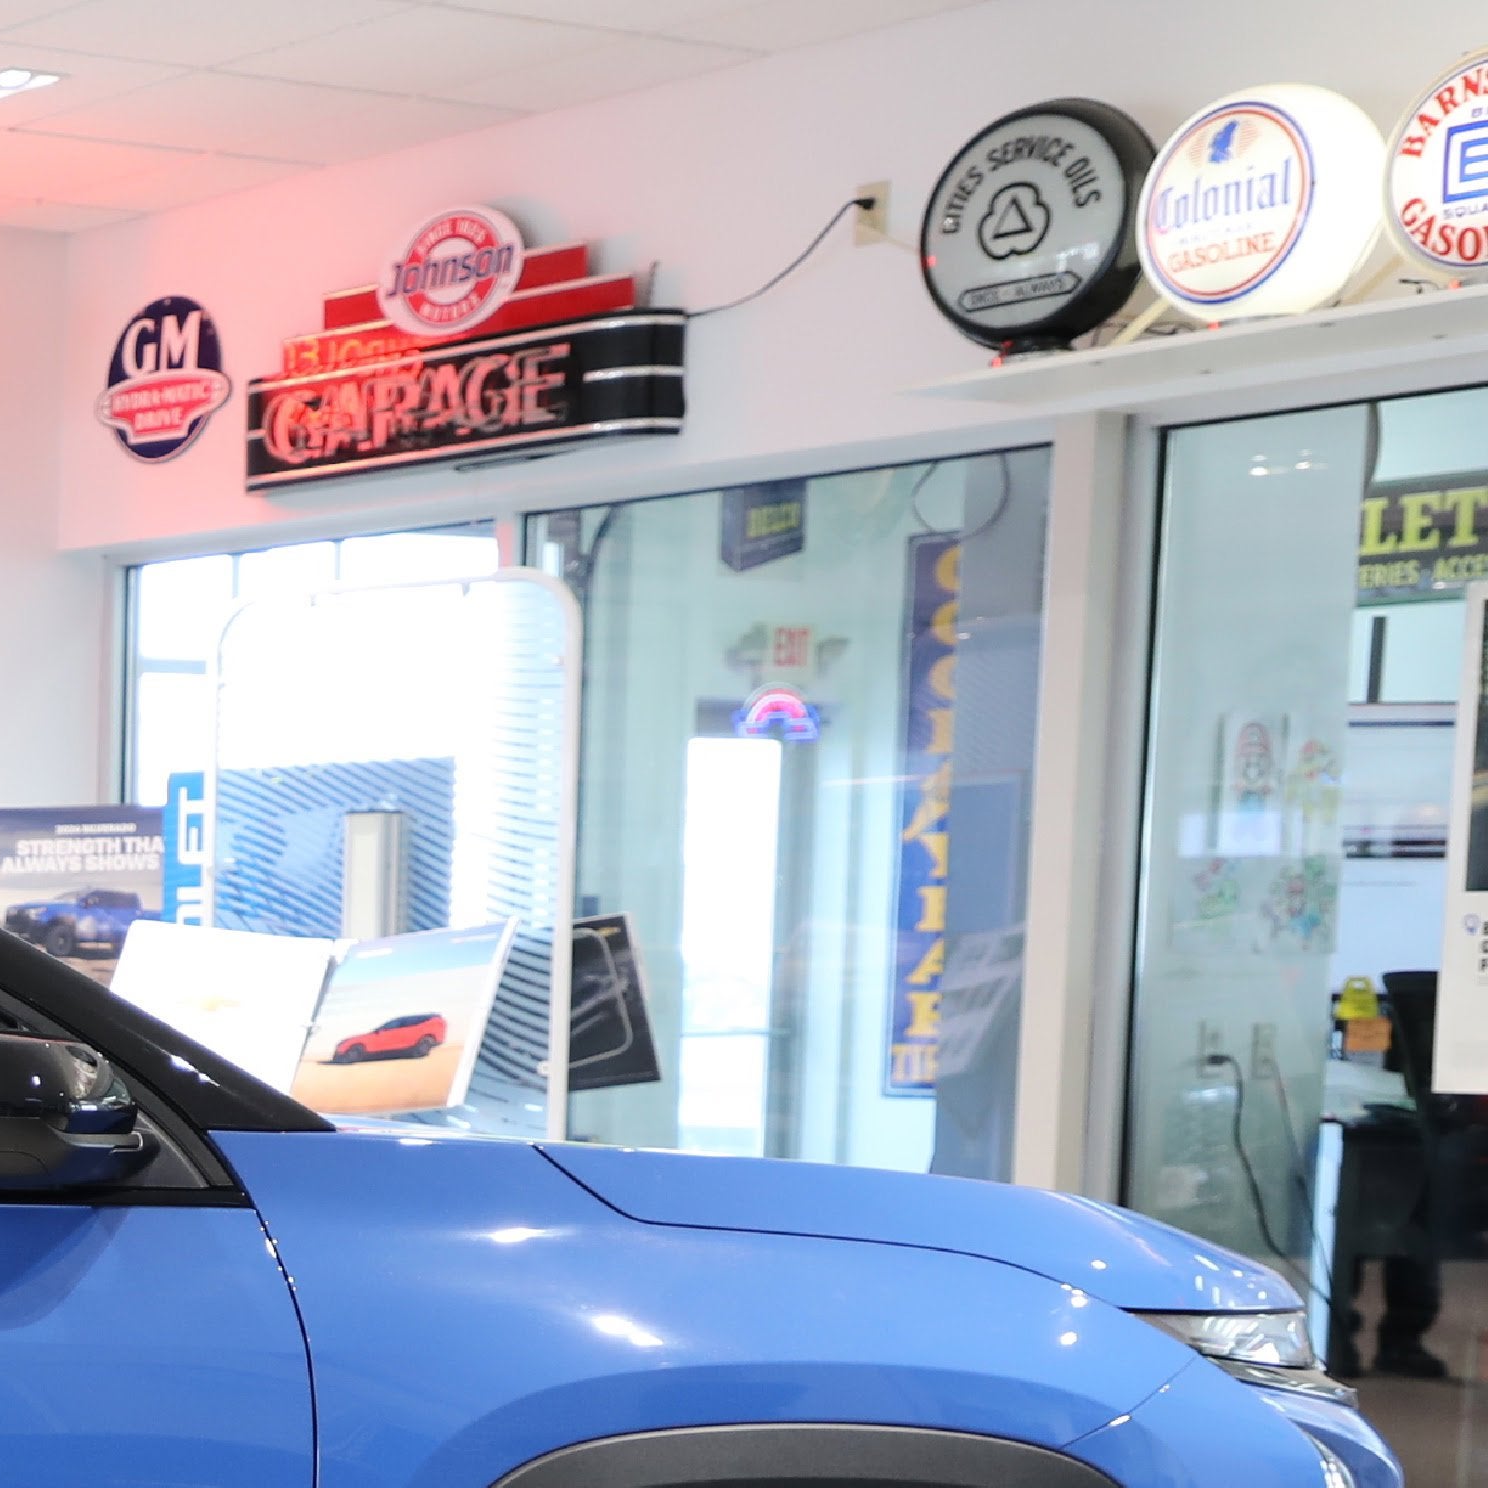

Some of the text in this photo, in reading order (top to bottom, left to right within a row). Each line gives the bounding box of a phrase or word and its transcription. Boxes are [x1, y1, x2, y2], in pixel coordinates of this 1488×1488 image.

[942, 136, 1102, 235] CITIES SERVICE OILS
[1155, 157, 1292, 234] Colonial
[1167, 231, 1277, 274] GASOLINE
[1400, 198, 1488, 262] GASO
[385, 244, 515, 299] Johnson
[122, 311, 202, 377] GM
[263, 342, 571, 465] GARAGE
[1, 854, 160, 874] ALWAYS SHOWS
[16, 837, 121, 856] STRENGTH
